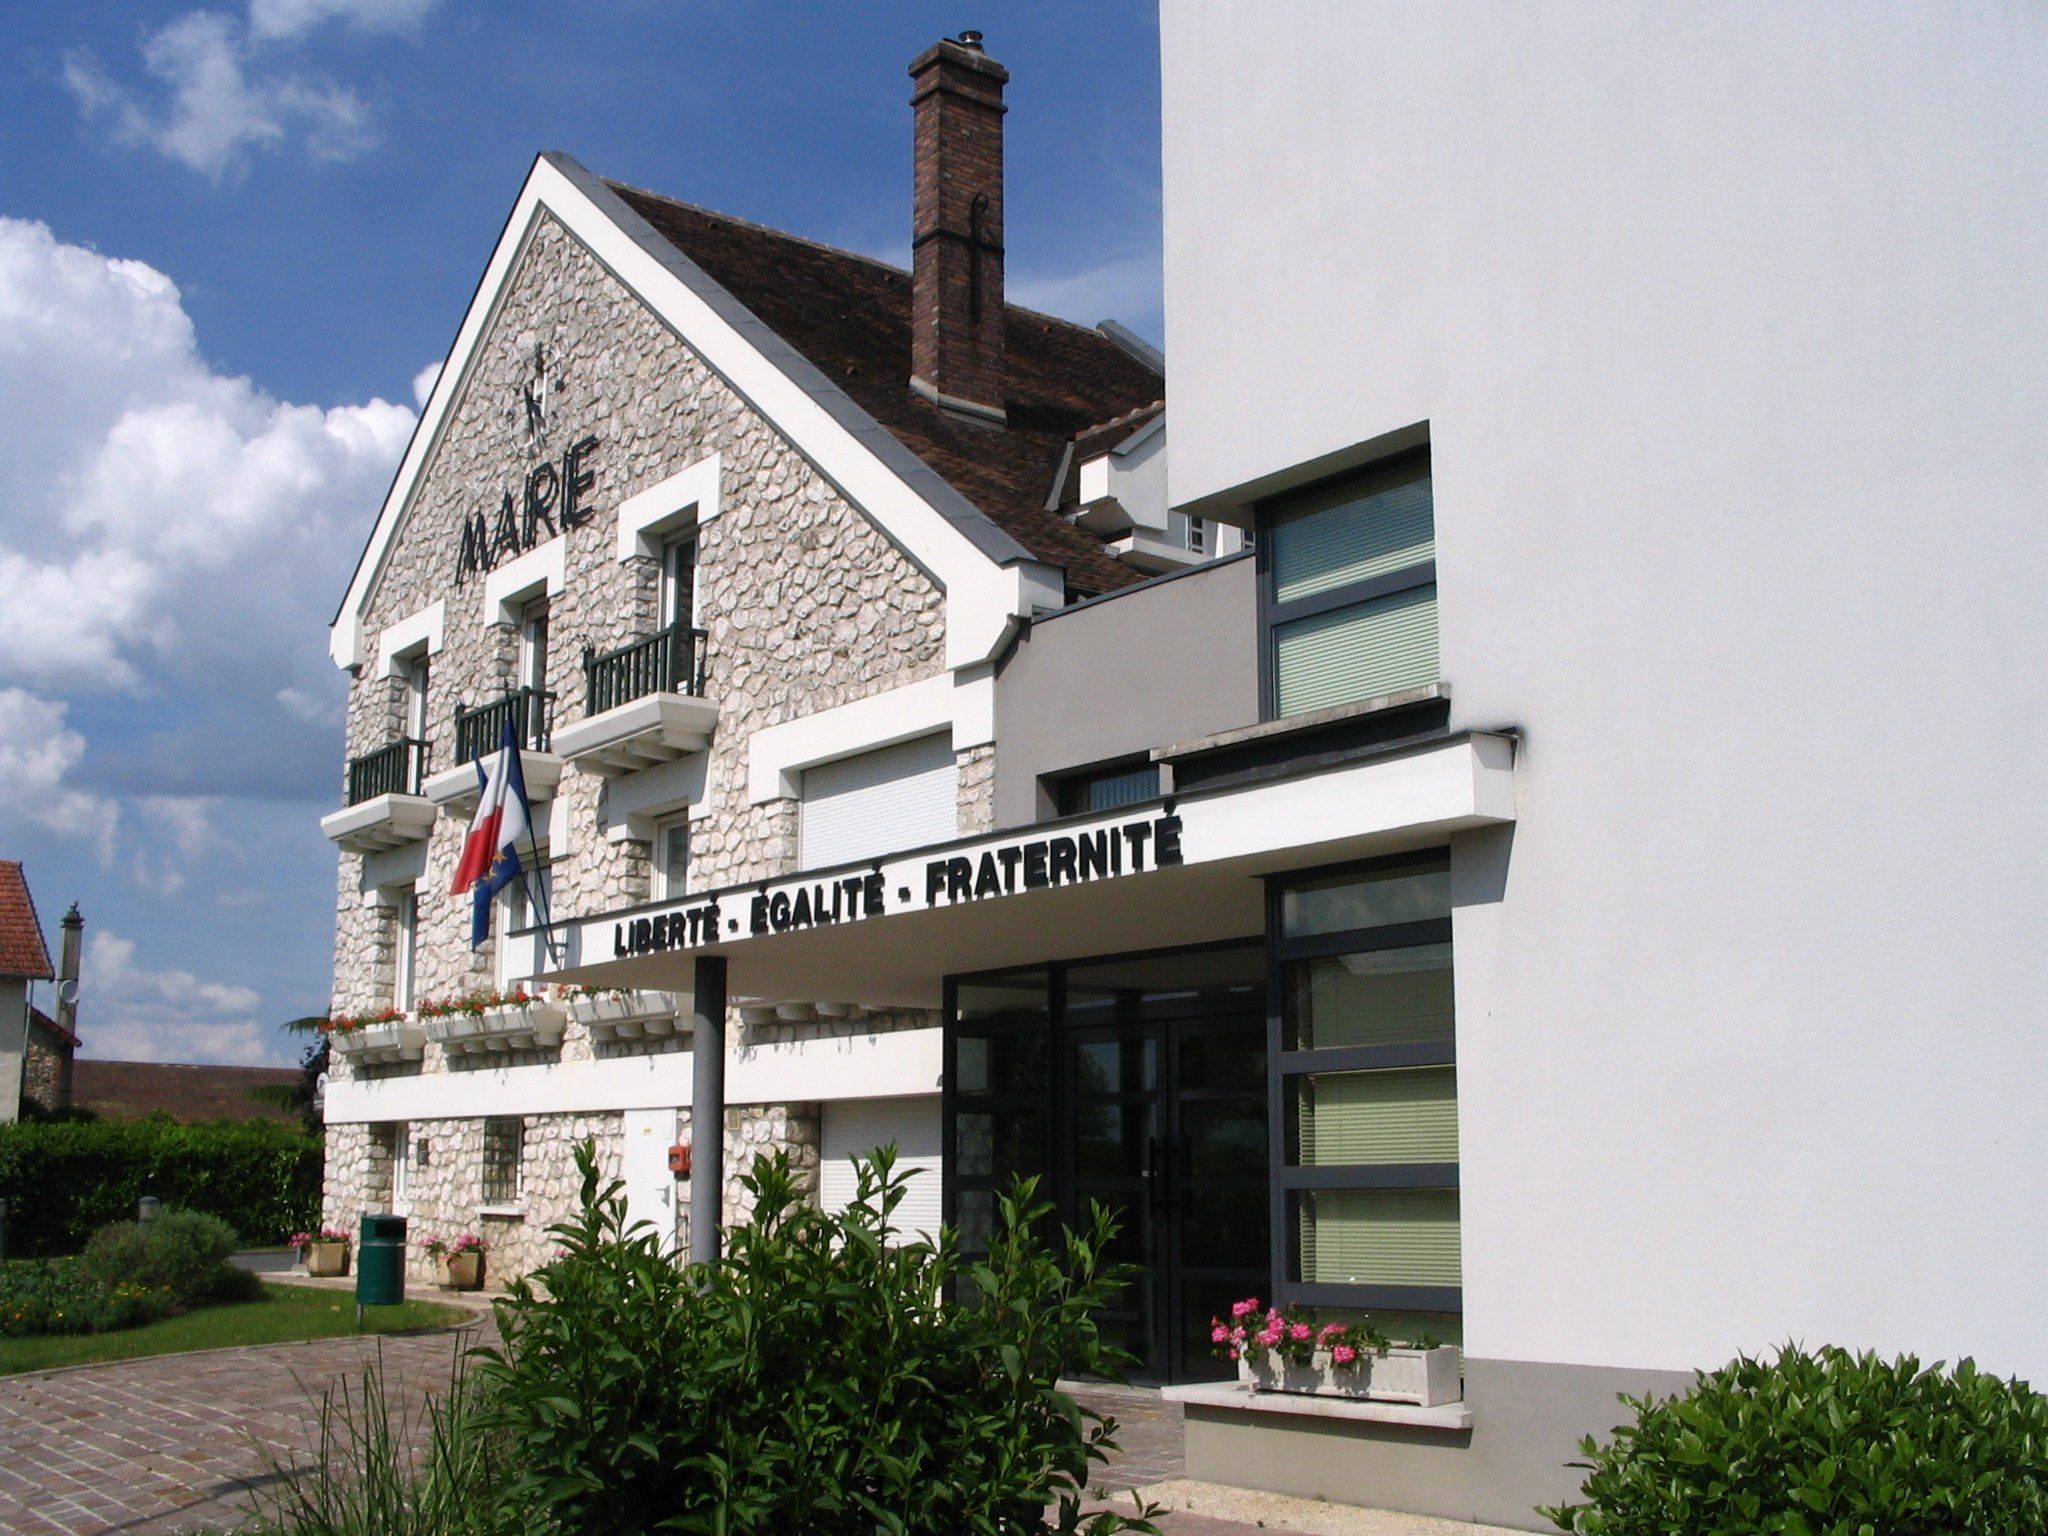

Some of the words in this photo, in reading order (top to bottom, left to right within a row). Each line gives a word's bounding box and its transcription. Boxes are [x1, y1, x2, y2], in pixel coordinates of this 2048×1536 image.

[454, 434, 598, 588] MAIRIE
[613, 893, 721, 958] LIBERTÉ
[749, 862, 886, 937] ÉGALITÉ
[926, 800, 1183, 908] FRATERNITÉ
